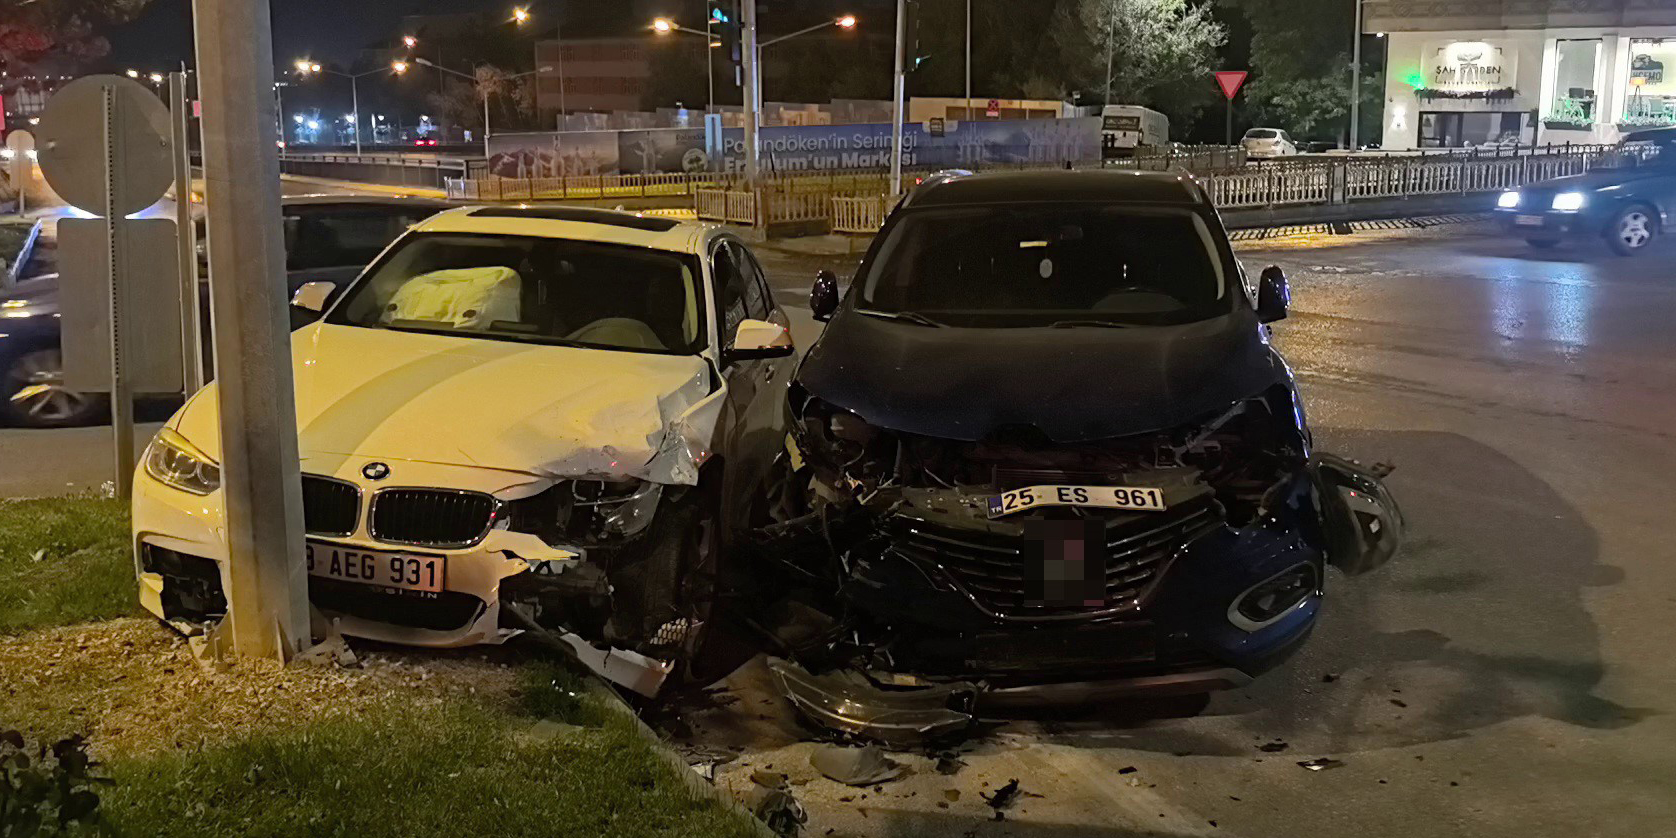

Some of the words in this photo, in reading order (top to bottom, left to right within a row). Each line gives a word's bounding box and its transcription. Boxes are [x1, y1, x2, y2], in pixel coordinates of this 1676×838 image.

[853, 131, 917, 152] Serinği
[842, 150, 916, 169] Marksı
[1003, 488, 1035, 511] 25
[1056, 486, 1089, 503] ES
[1114, 488, 1159, 508] 961
[329, 549, 375, 580] AEG
[389, 557, 435, 587] 931
